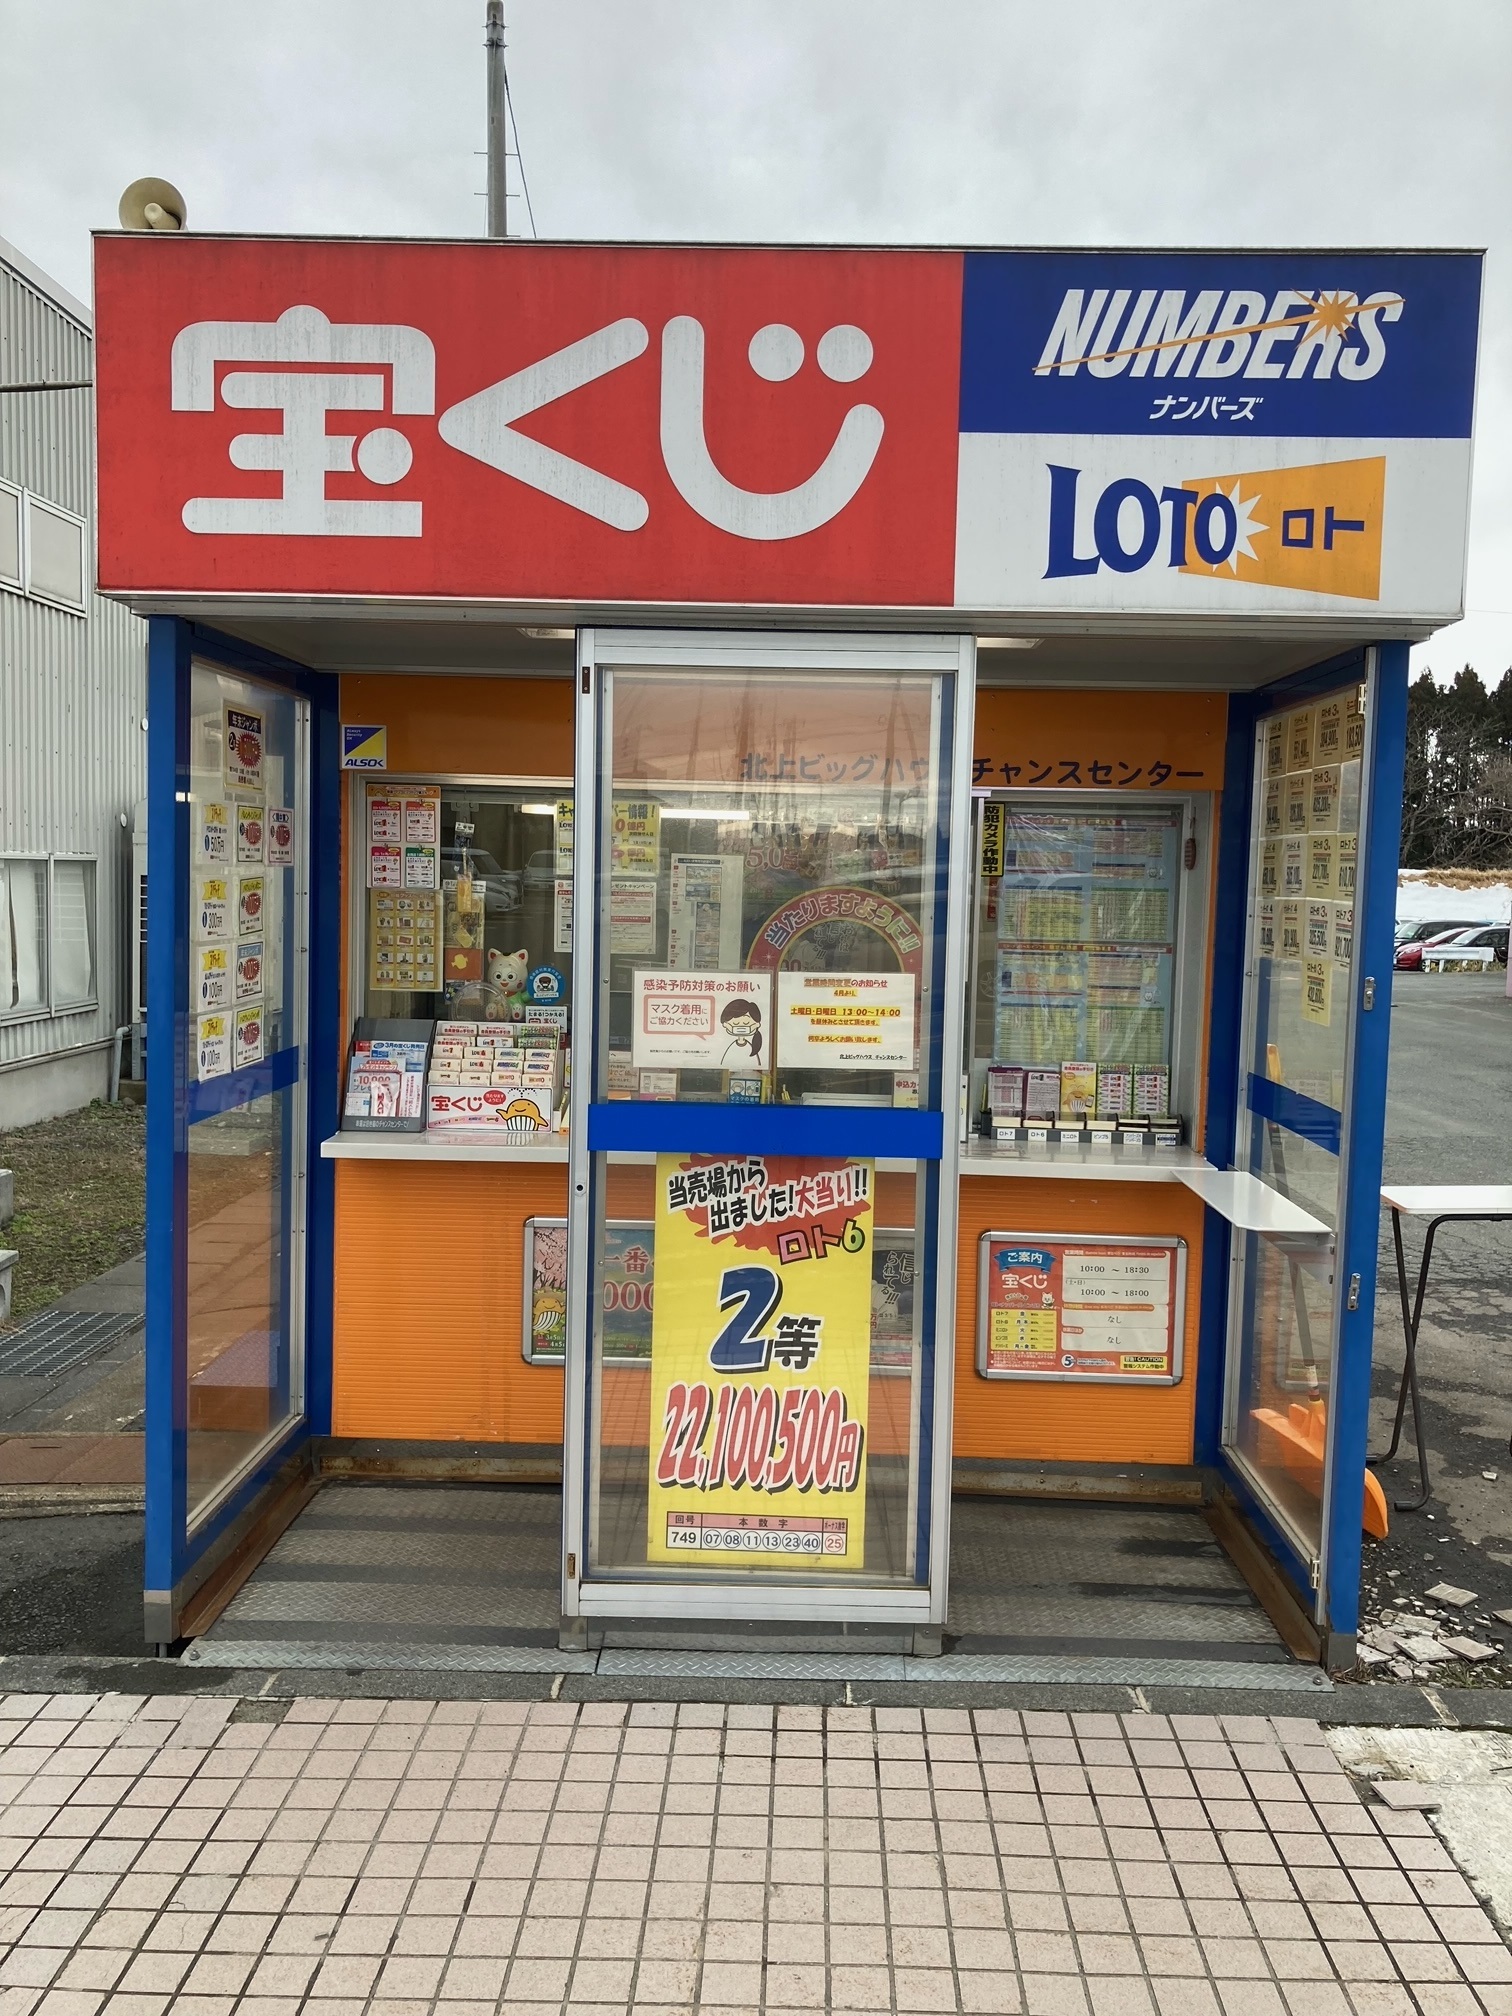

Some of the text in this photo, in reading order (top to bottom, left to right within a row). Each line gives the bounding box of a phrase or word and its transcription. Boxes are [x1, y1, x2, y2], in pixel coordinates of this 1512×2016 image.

[1035, 288, 1402, 381] NUMBERS
[1150, 394, 1264, 420] ナンバーズ
[171, 305, 884, 540] 宝くじ
[1041, 464, 1237, 579] LOTO
[1282, 507, 1364, 551] ロト
[345, 759, 384, 767] ALSOK
[741, 752, 1204, 787] 北上ビッグハウチャンスセンター
[983, 806, 1000, 874] 防犯カメラ作動中
[765, 894, 922, 954] 当たりますように!!
[643, 978, 761, 993] 感染予防対策のお願い
[804, 978, 888, 988] 営業時間変更のお知らせ
[651, 1003, 708, 1015] マスク着用に
[791, 1007, 837, 1015] 土曜日・日曜日
[650, 1016, 709, 1026] ご協力ください
[896, 1080, 919, 1088] 申込カ
[431, 1095, 482, 1112] 宝くじ
[668, 1158, 766, 1210] 当売場から
[709, 1167, 869, 1234] 出ました!大当り!!
[777, 1219, 866, 1266] ロト6
[1008, 1251, 1043, 1264] ご案内
[1080, 1265, 1105, 1273] 10:00
[1124, 1266, 1150, 1274] 18:30
[1002, 1273, 1047, 1289] 宝くじ
[1080, 1288, 1106, 1296] 10:00
[1125, 1289, 1150, 1297] 18:00
[709, 1265, 823, 1372] 2等
[1107, 1315, 1122, 1324] なし
[1107, 1336, 1122, 1345] なし
[657, 1383, 863, 1493] 22,100,500円
[675, 1514, 695, 1525] 回号
[671, 1531, 697, 1544] 749
[705, 1534, 819, 1548] 07 08 11 13 23 40
[827, 1538, 842, 1549] 25
